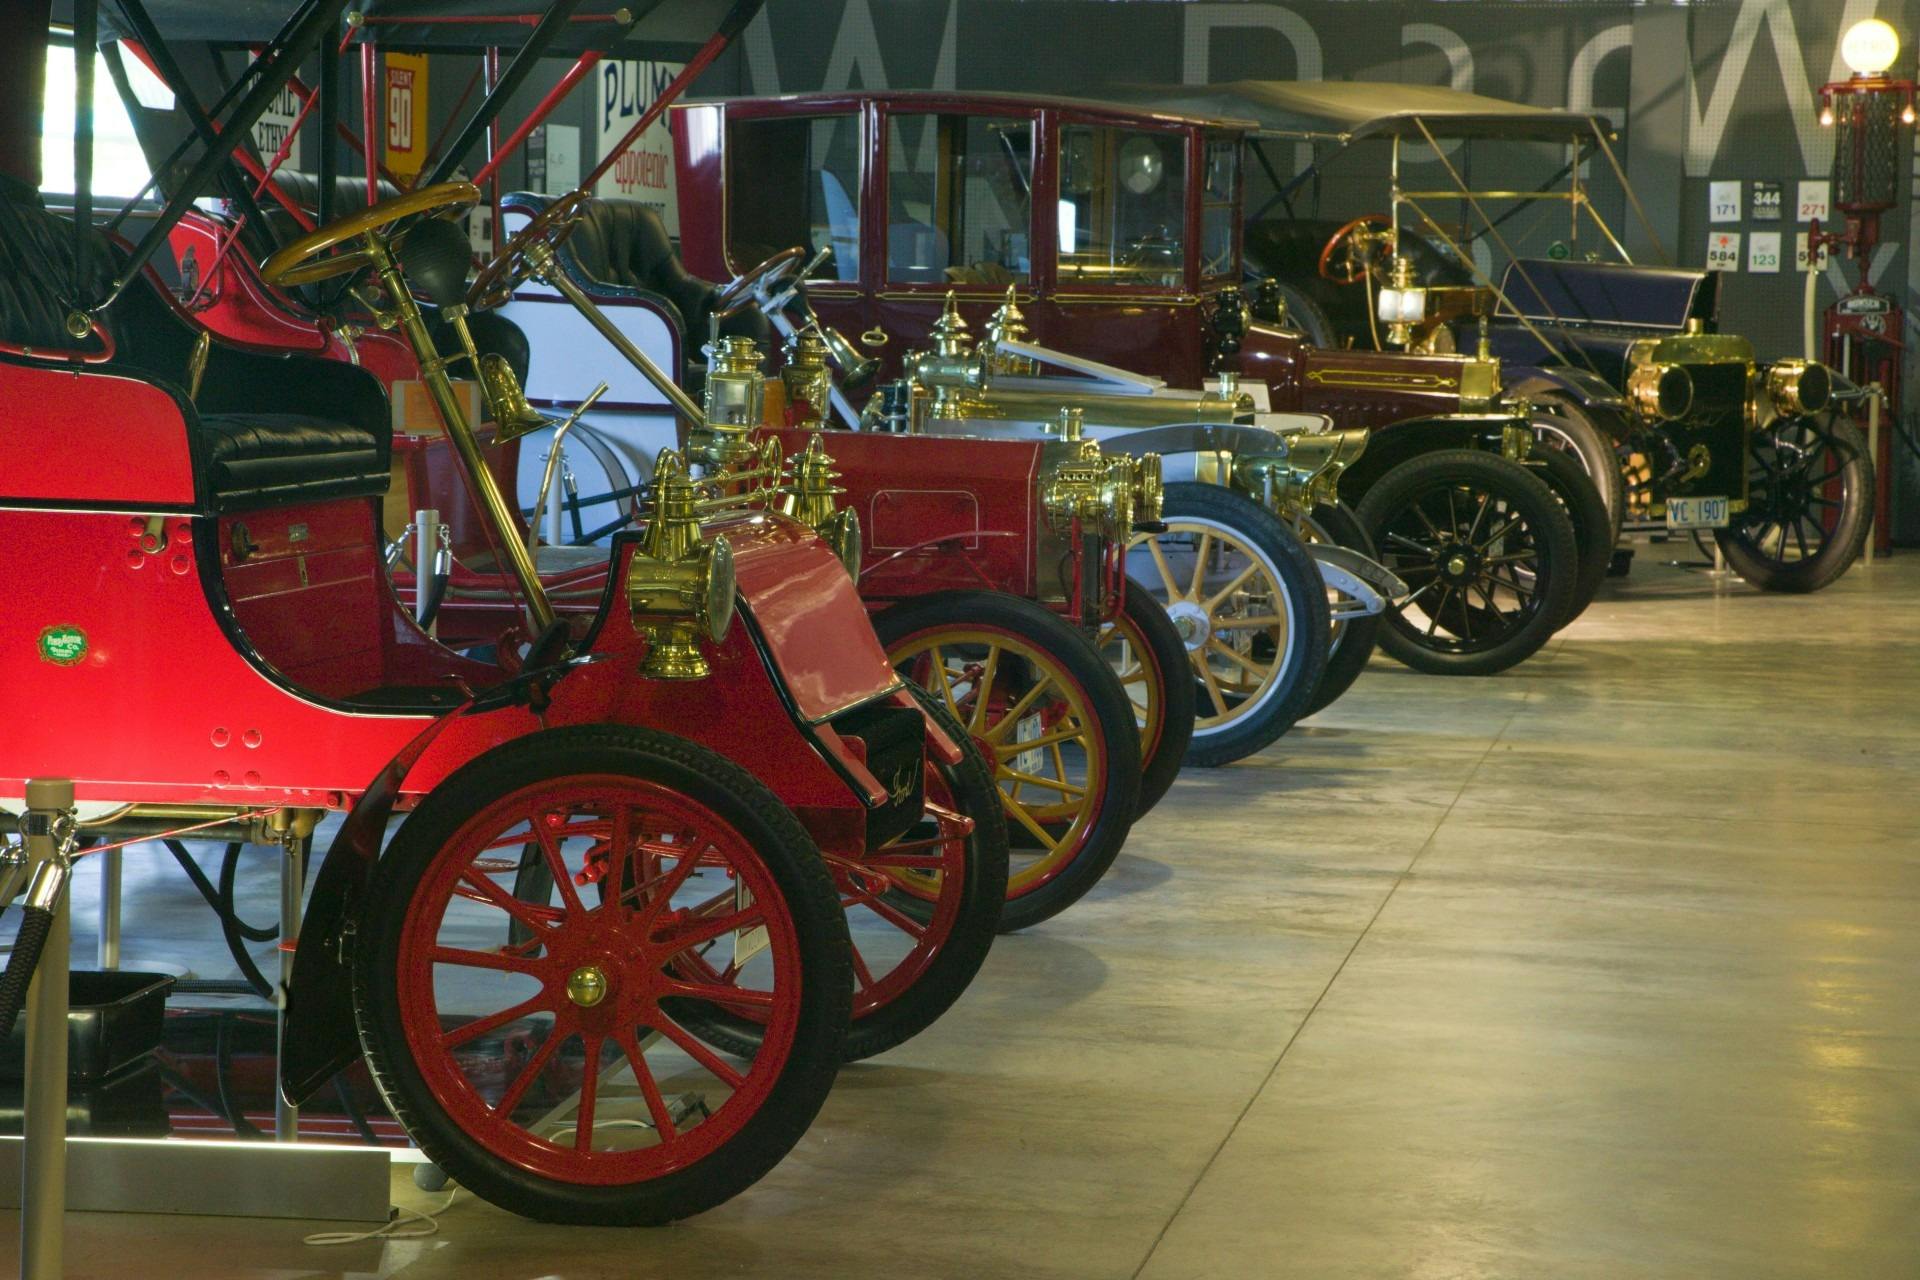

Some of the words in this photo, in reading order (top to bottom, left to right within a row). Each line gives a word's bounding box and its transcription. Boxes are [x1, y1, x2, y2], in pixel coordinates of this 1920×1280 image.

[604, 59, 673, 136] PLUM
[390, 88, 411, 148] 90
[258, 121, 290, 154] ETHY
[1753, 191, 1780, 206] 344
[1716, 204, 1736, 216] 171
[1801, 204, 1826, 216] 271
[1709, 250, 1736, 262] 584
[1752, 254, 1777, 266] 123
[1798, 251, 1825, 262] 54
